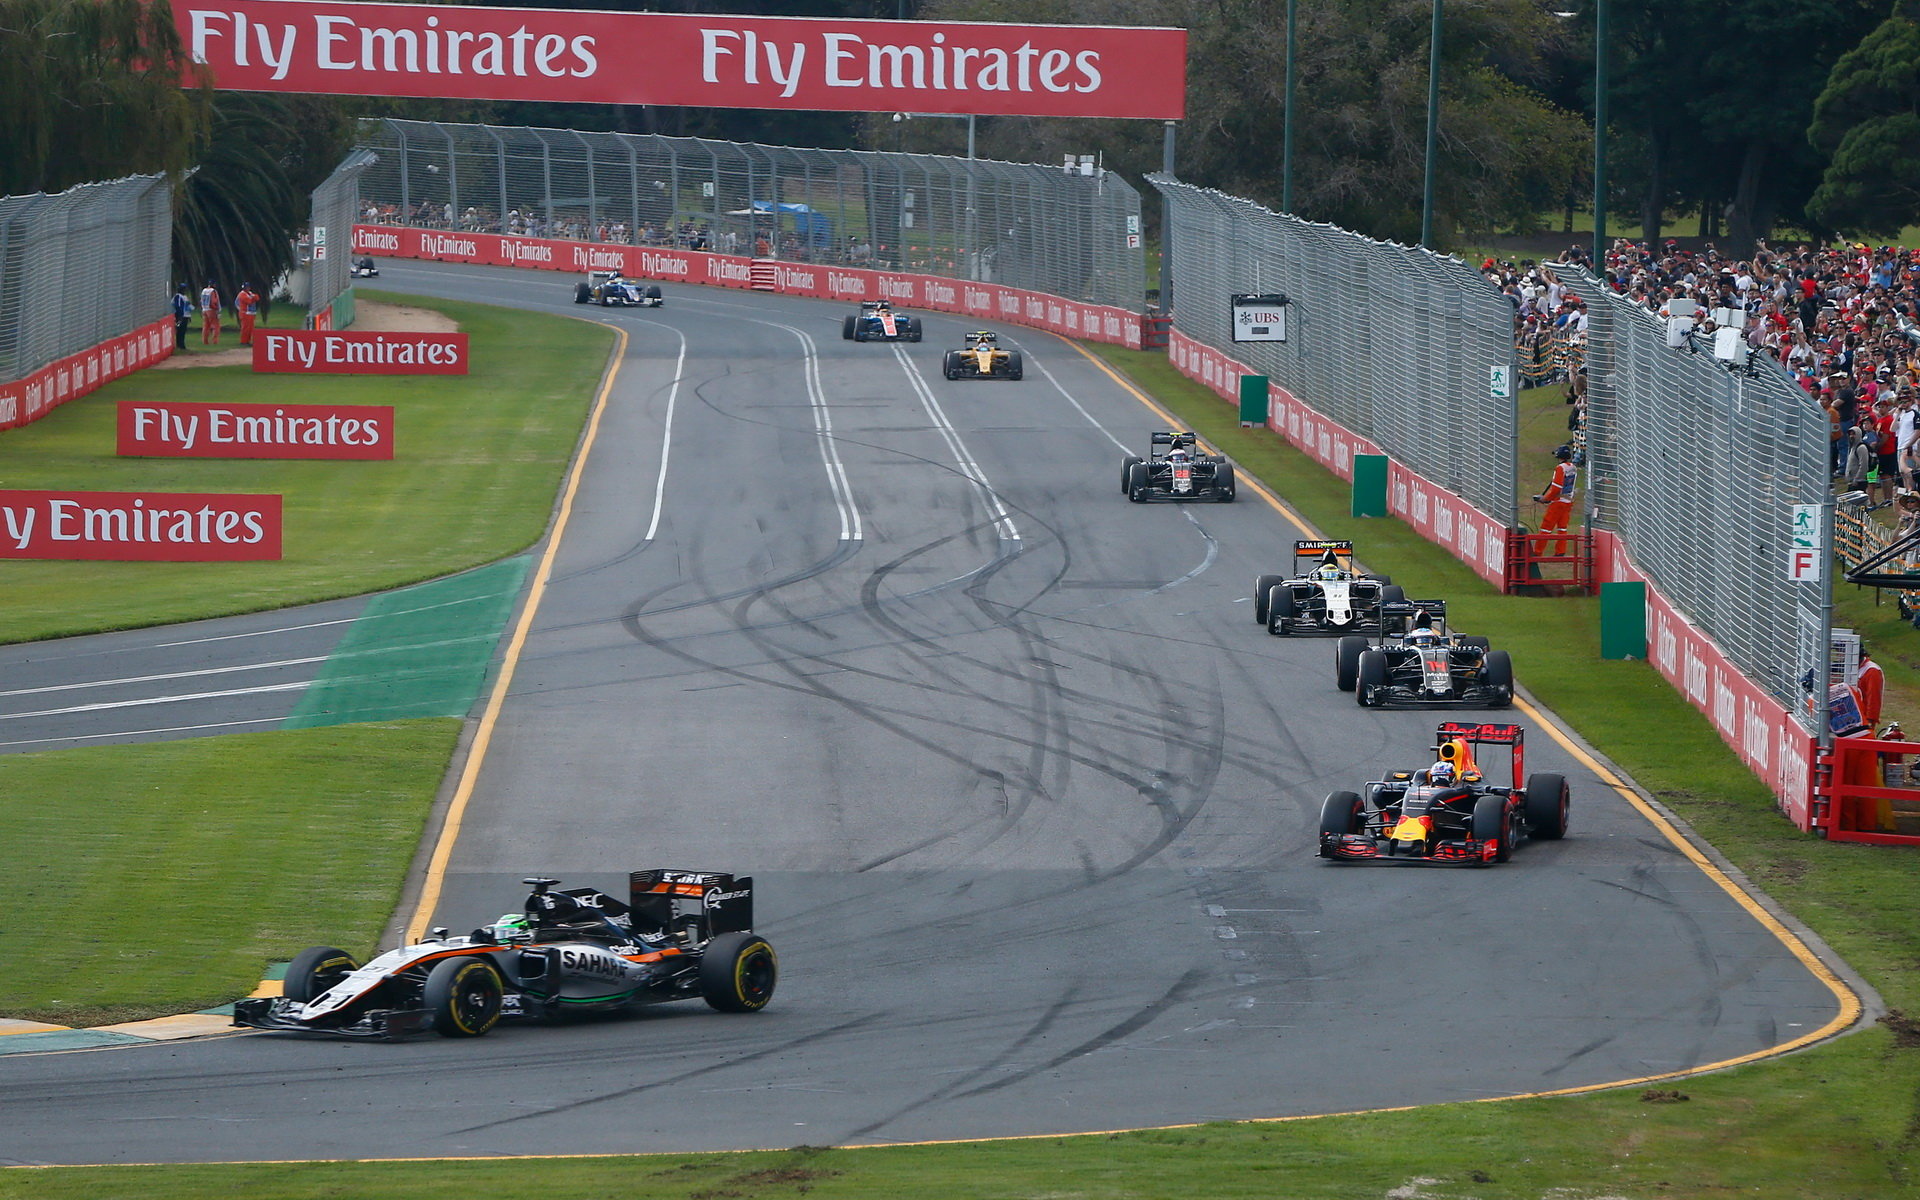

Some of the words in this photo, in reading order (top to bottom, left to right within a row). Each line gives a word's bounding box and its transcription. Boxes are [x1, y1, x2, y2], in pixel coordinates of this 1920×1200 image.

[188, 10, 296, 80] Fly
[314, 15, 598, 78] Emirates
[700, 28, 805, 98] Fly
[822, 32, 1101, 94] Emirates
[359, 229, 398, 250] Emirates
[421, 234, 437, 257] Fly
[437, 235, 476, 256] Emirates
[501, 239, 515, 263] Fly
[517, 240, 552, 262] Emirates
[1129, 236, 1137, 247] F
[316, 247, 324, 258] F
[573, 246, 588, 269] Fly
[589, 246, 624, 269] Emirates
[642, 252, 655, 276] Fly
[656, 254, 688, 275] Emirates
[707, 257, 720, 282] Fly
[720, 259, 751, 281] Emirates
[774, 266, 786, 291] Fly
[786, 267, 815, 289] Emirates
[1254, 312, 1280, 323] UBS
[266, 335, 317, 368] Fly
[324, 335, 458, 365] Emirates
[133, 408, 199, 449] Fly
[208, 409, 379, 446] Emirates
[48, 498, 264, 544] Emirates
[1795, 552, 1813, 578] F
[571, 893, 604, 909] NEC
